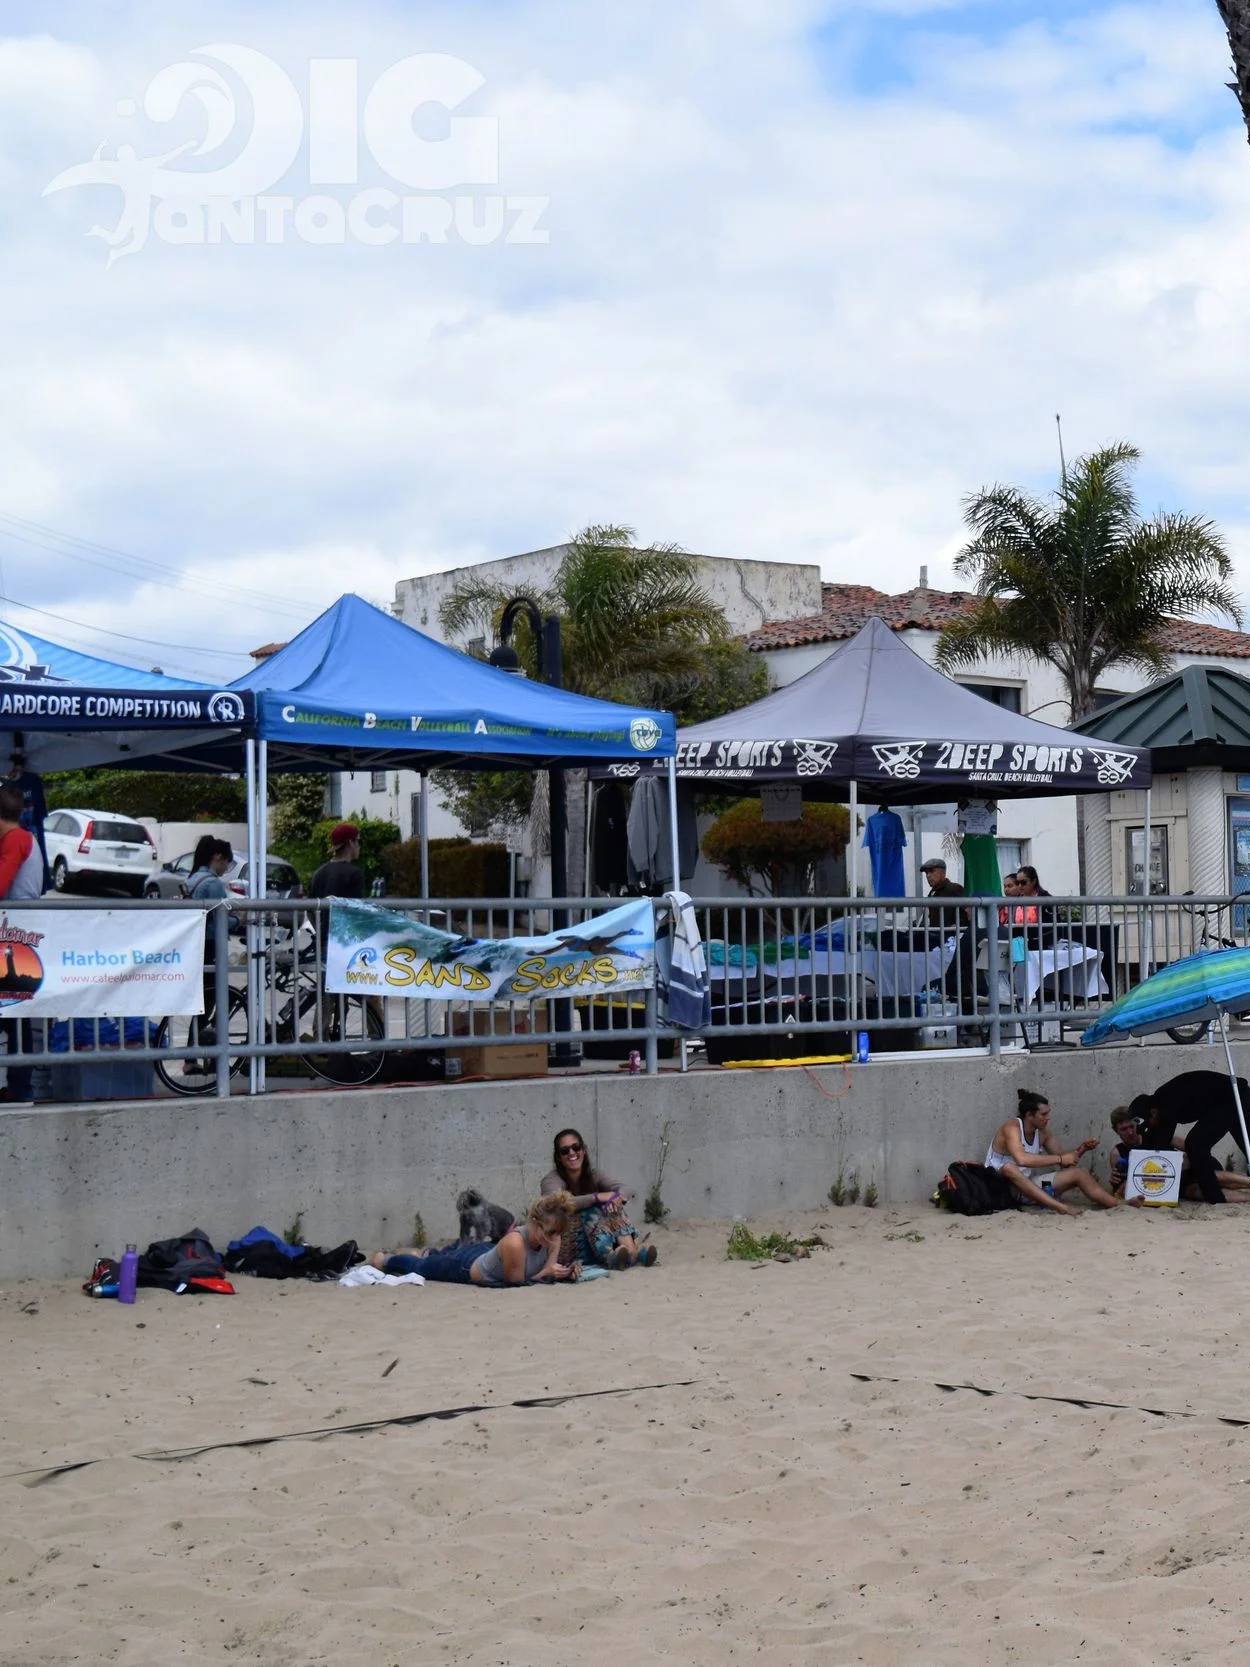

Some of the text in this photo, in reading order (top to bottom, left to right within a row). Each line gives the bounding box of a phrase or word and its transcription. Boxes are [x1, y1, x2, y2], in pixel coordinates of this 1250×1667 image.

[85, 697, 201, 719] COMPETITION
[652, 740, 787, 768] EEP SPORTS
[934, 742, 1083, 773] 2DEEP SPORTS
[968, 772, 1053, 783] SANTA CRUZ BEACH VOLLEYBALL
[62, 949, 181, 966] Harbor Beach
